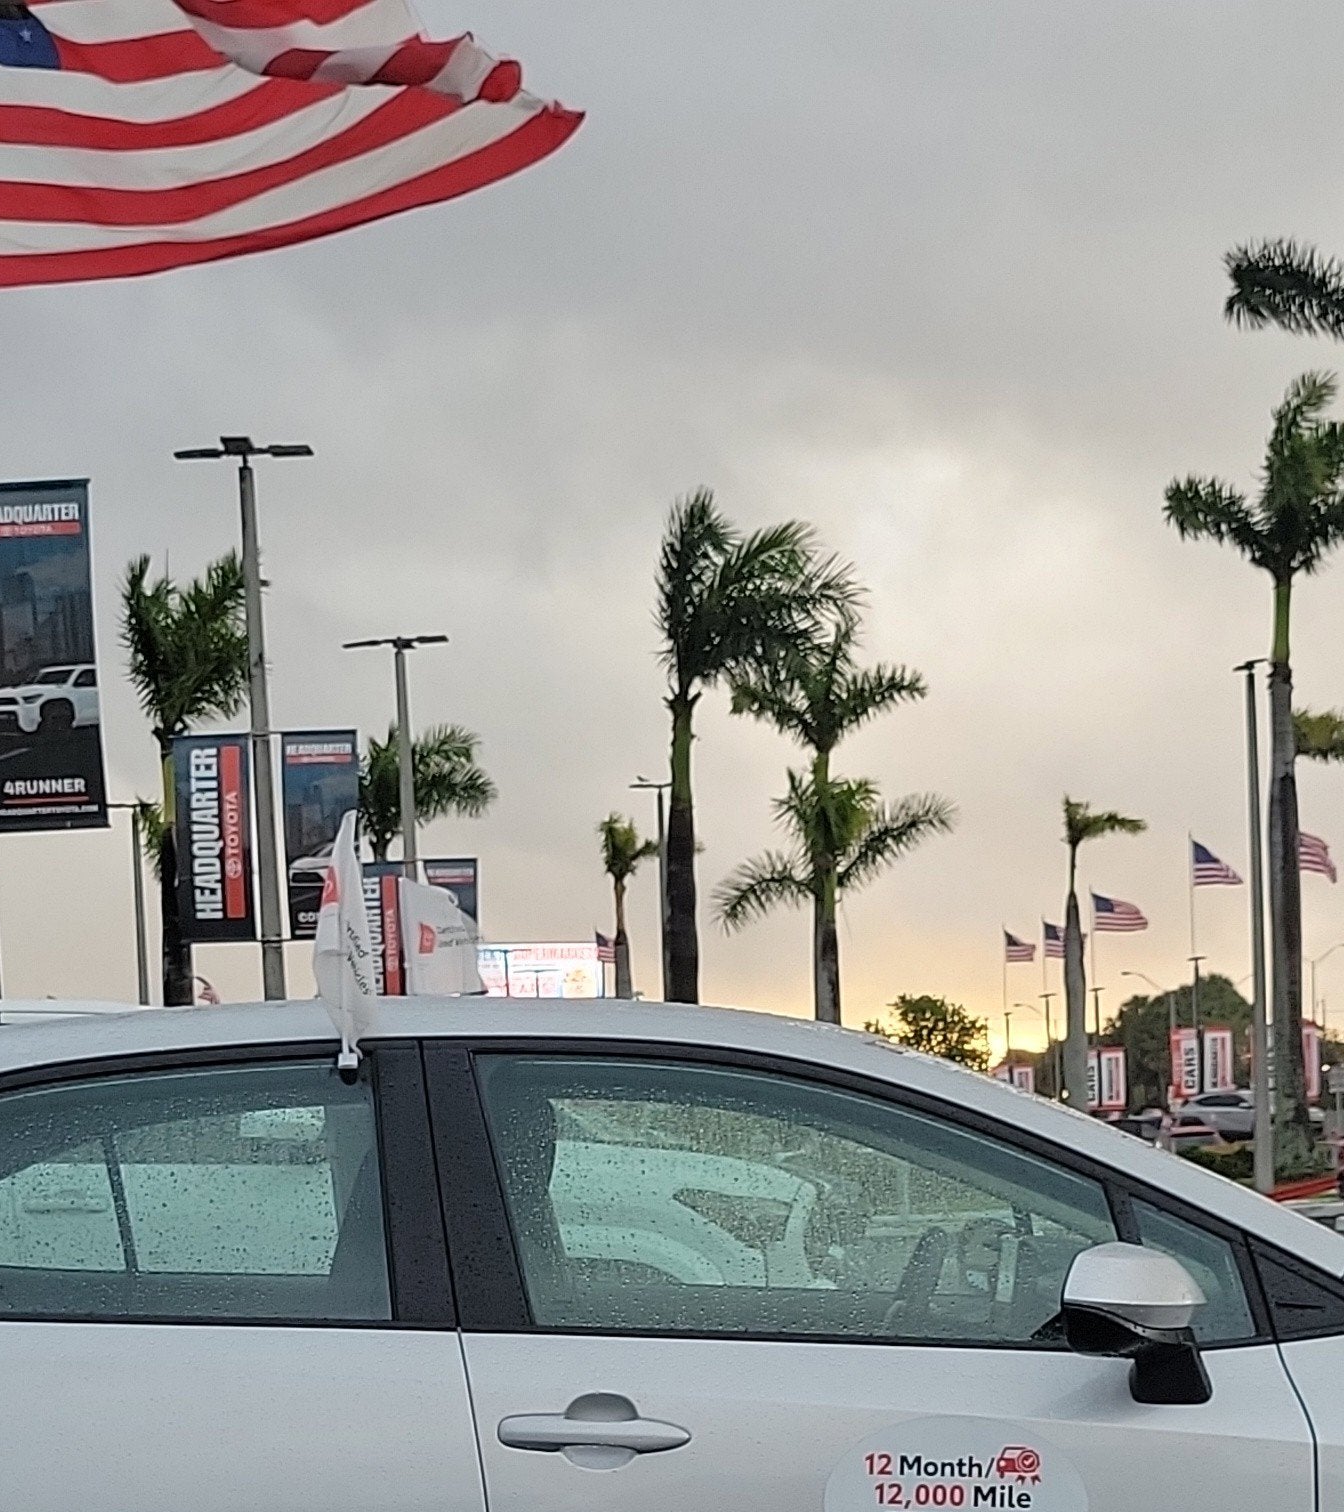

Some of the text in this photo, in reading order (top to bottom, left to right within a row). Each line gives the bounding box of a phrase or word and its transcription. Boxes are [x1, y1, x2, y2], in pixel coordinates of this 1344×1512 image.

[3, 778, 86, 795] 4RUNNER
[190, 747, 223, 920] HEADQUARTER
[225, 793, 239, 857] TOYOTA
[297, 911, 320, 922] CO
[385, 909, 397, 956] TOYOTA
[1184, 1047, 1196, 1089] CARS
[864, 1453, 996, 1479] 12 Month/
[874, 1483, 1032, 1510] 12,000 Mile
